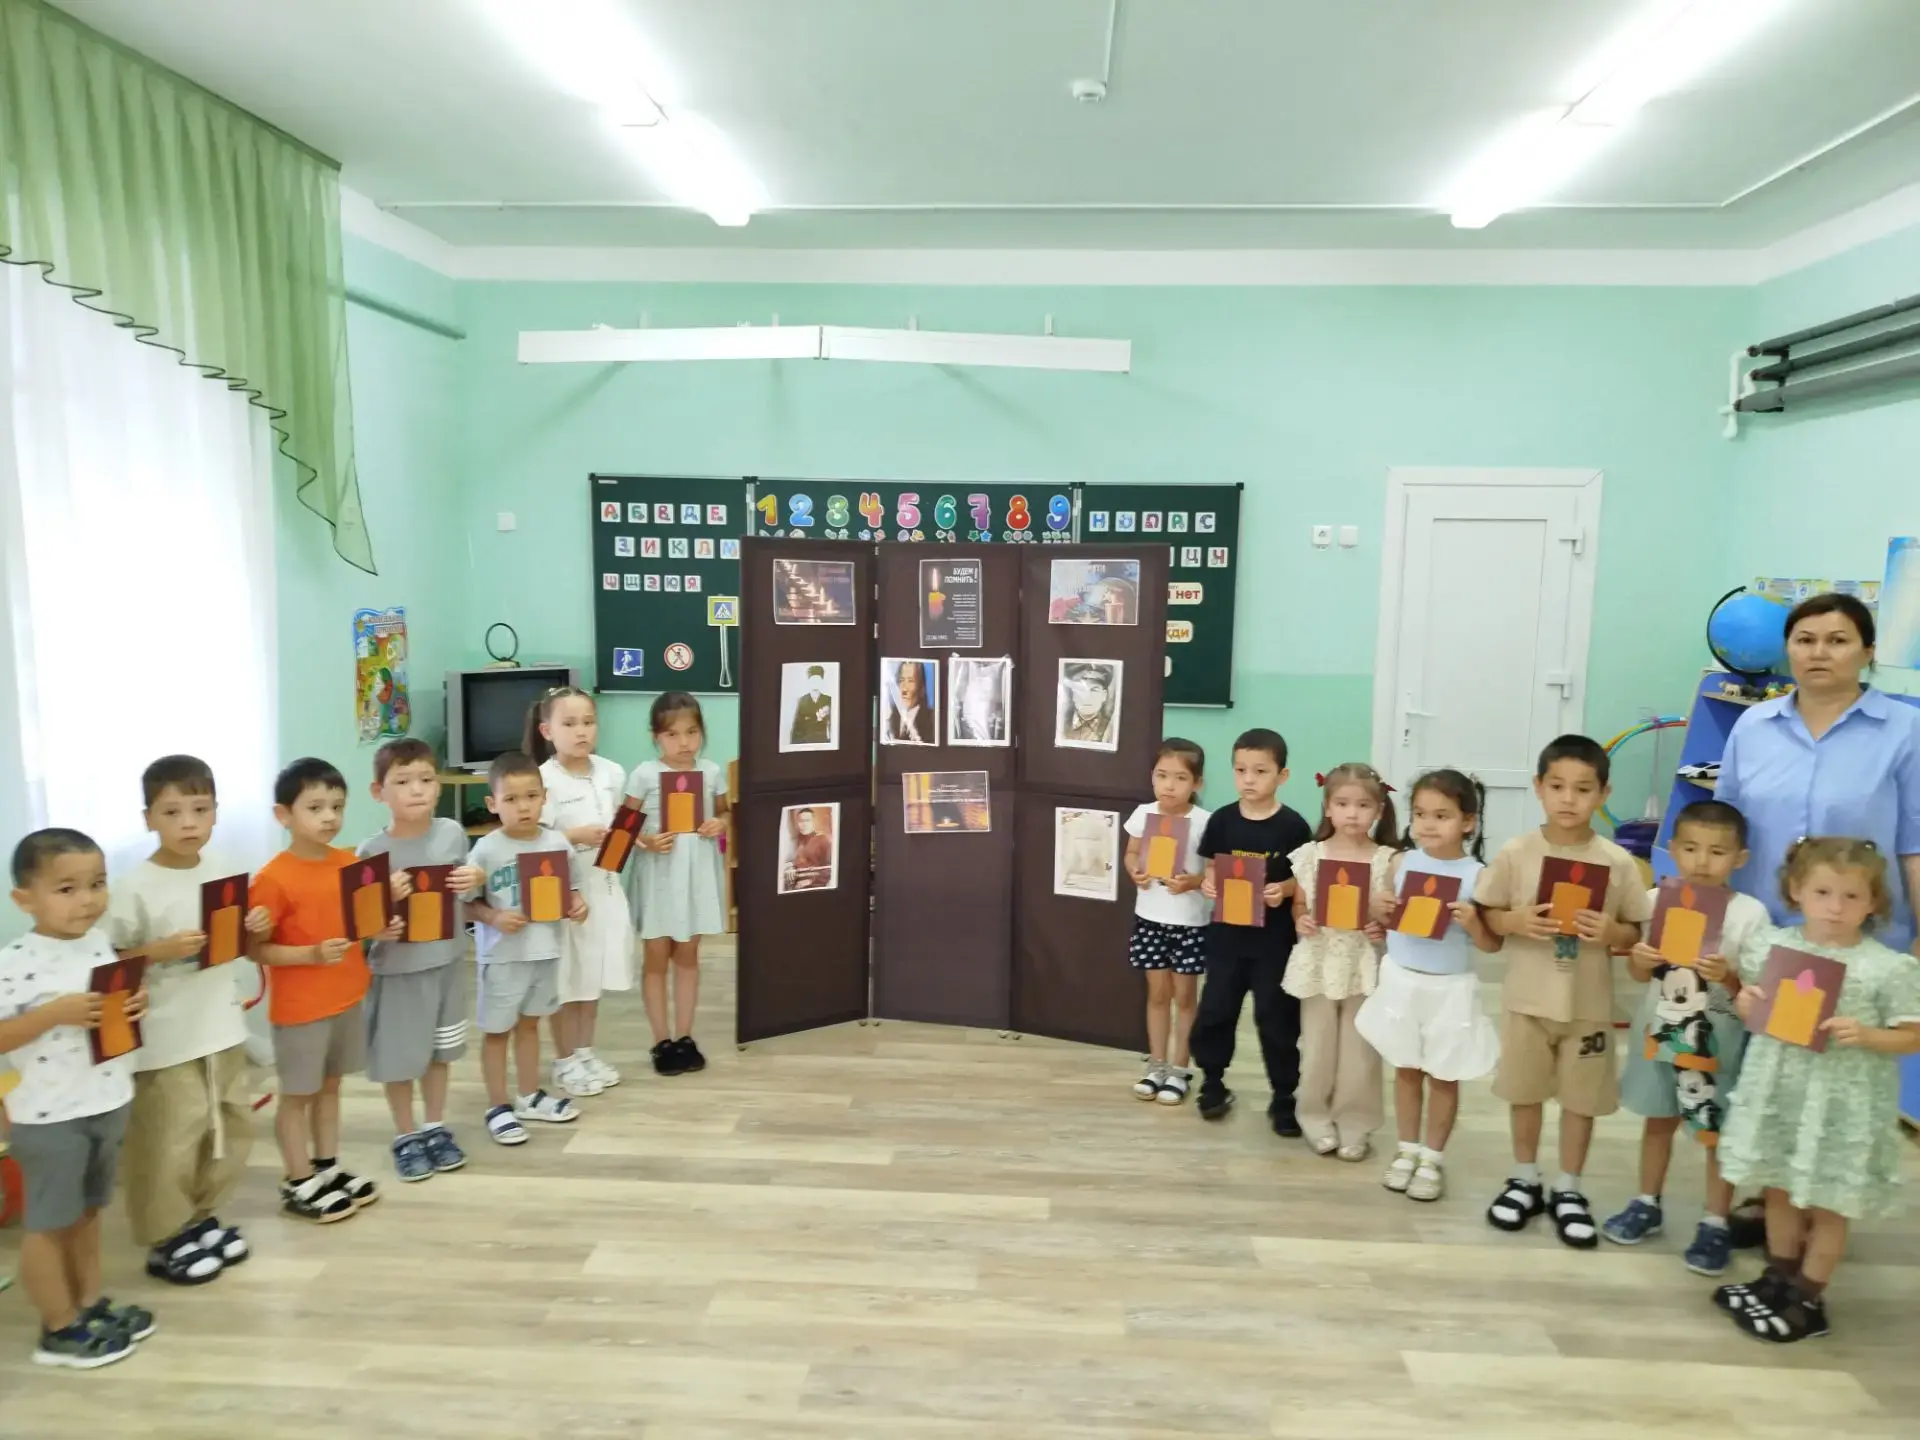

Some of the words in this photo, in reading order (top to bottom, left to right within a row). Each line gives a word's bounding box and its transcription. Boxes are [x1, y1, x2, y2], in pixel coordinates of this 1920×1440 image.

[603, 503, 617, 519] А
[631, 505, 645, 520] Б
[658, 505, 671, 521] В
[684, 505, 698, 521] Д
[711, 506, 722, 521] Е
[756, 494, 778, 526] 1
[788, 493, 815, 527] 2
[858, 492, 885, 528] 4
[896, 493, 921, 529] 5
[934, 494, 957, 530] 6
[967, 493, 992, 530] 7
[1006, 494, 1031, 531] 8
[1046, 494, 1071, 531] 9
[1092, 513, 1106, 528] Н
[1145, 513, 1159, 528] П
[1172, 513, 1184, 529] Р
[1200, 514, 1213, 530] С
[644, 539, 656, 554] И
[671, 540, 684, 554] К
[698, 541, 711, 555] Л
[723, 541, 738, 557] М
[1186, 548, 1199, 564] Ц
[1212, 549, 1225, 564] Ч
[666, 577, 679, 589] Ю
[687, 577, 697, 589] Я
